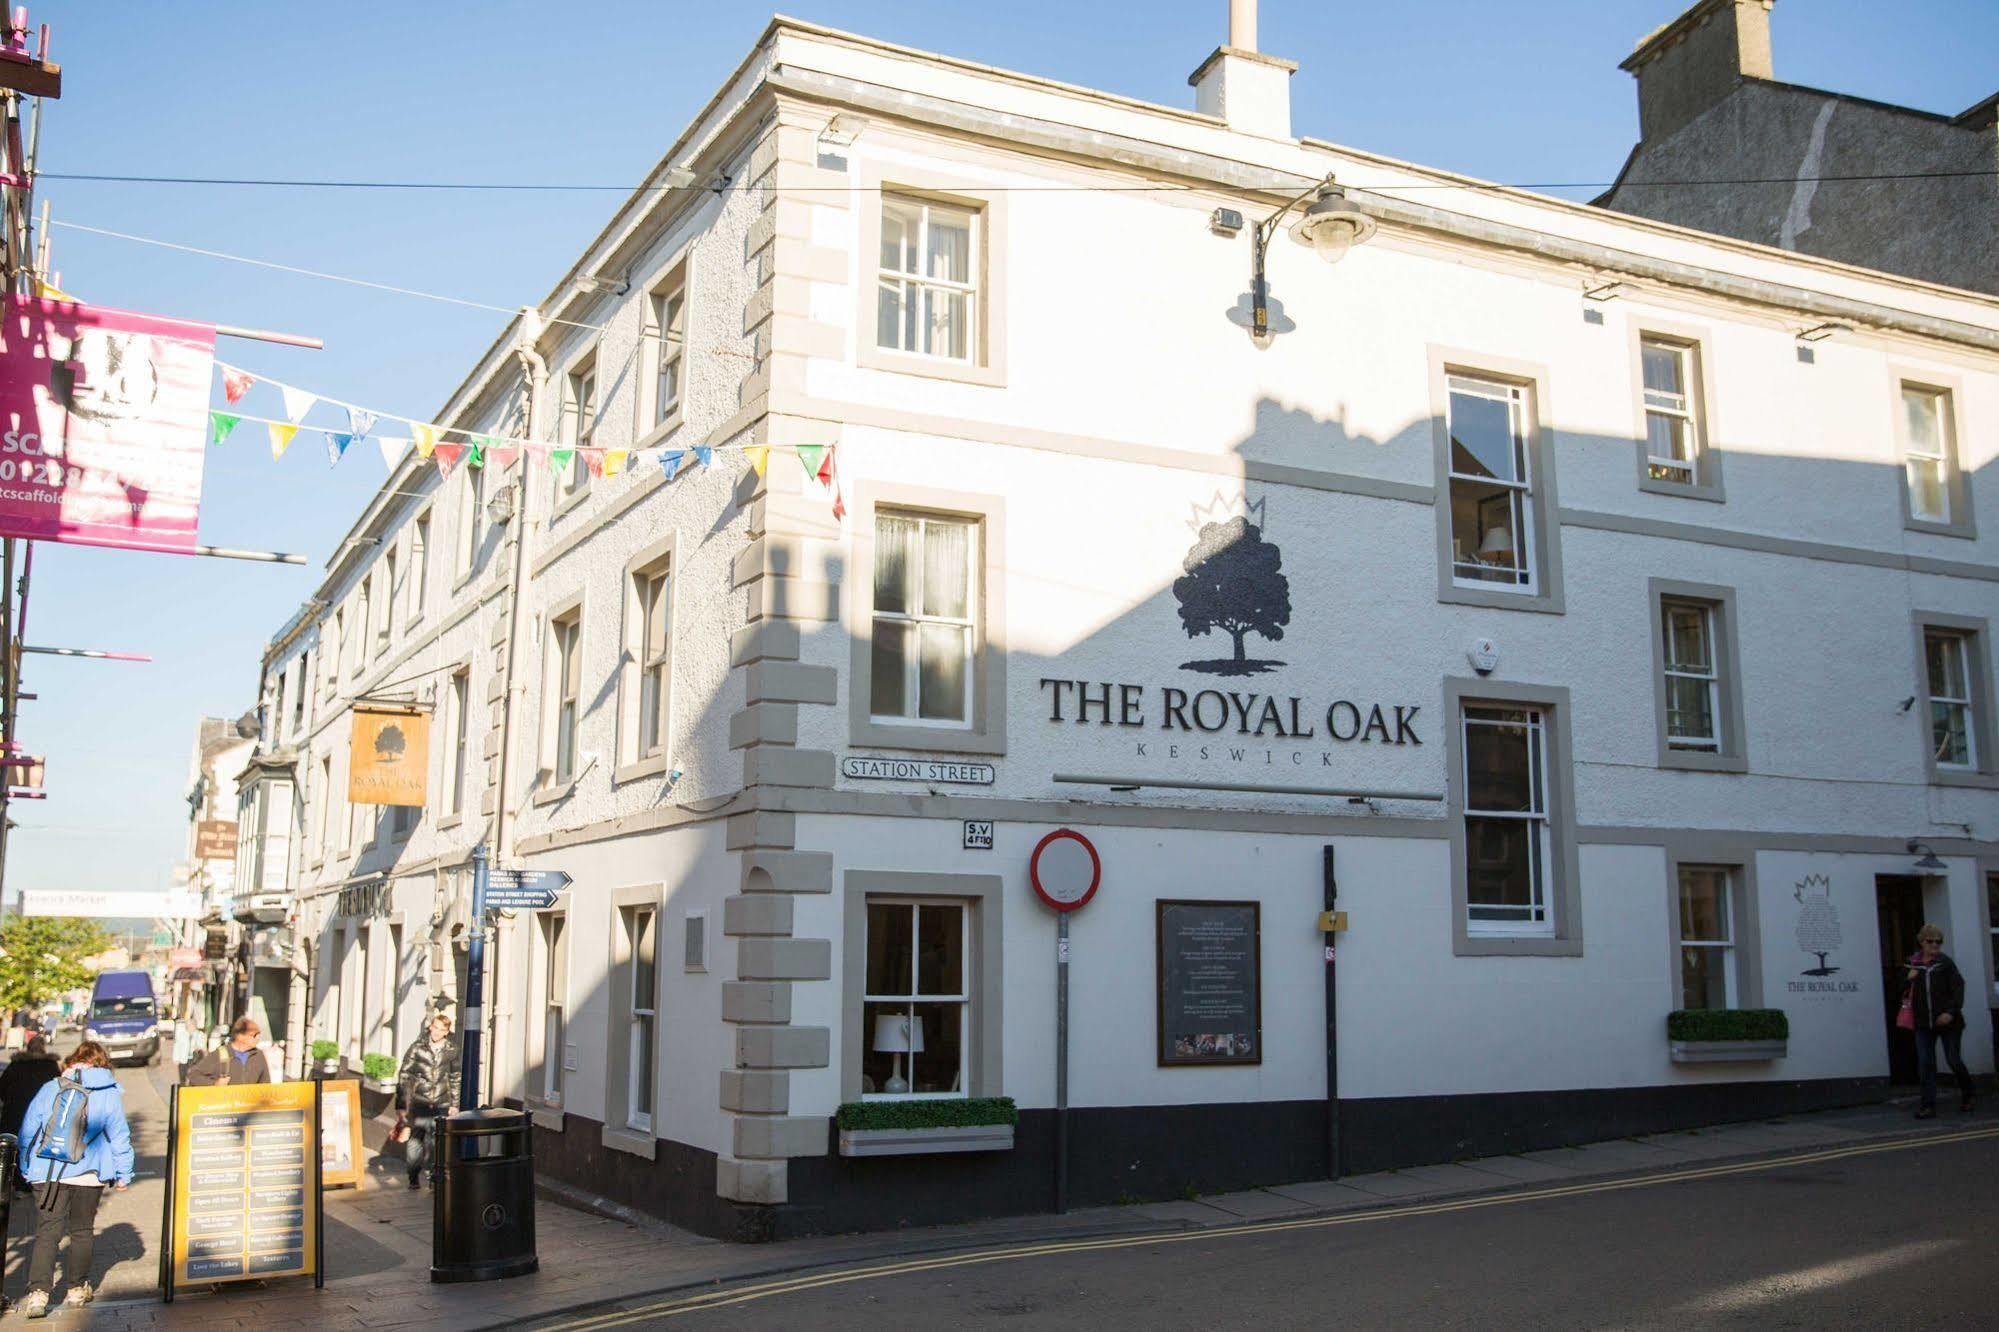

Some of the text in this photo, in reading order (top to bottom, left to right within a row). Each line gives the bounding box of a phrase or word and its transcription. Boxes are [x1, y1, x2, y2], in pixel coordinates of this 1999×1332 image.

[1040, 678, 1423, 745] THE ROYAL OAK
[1136, 743, 1332, 767] KESWICK
[850, 760, 987, 781] STATION STREET
[1787, 981, 1860, 992] THE ROYAL OAK
[203, 1117, 238, 1126] Cinema
